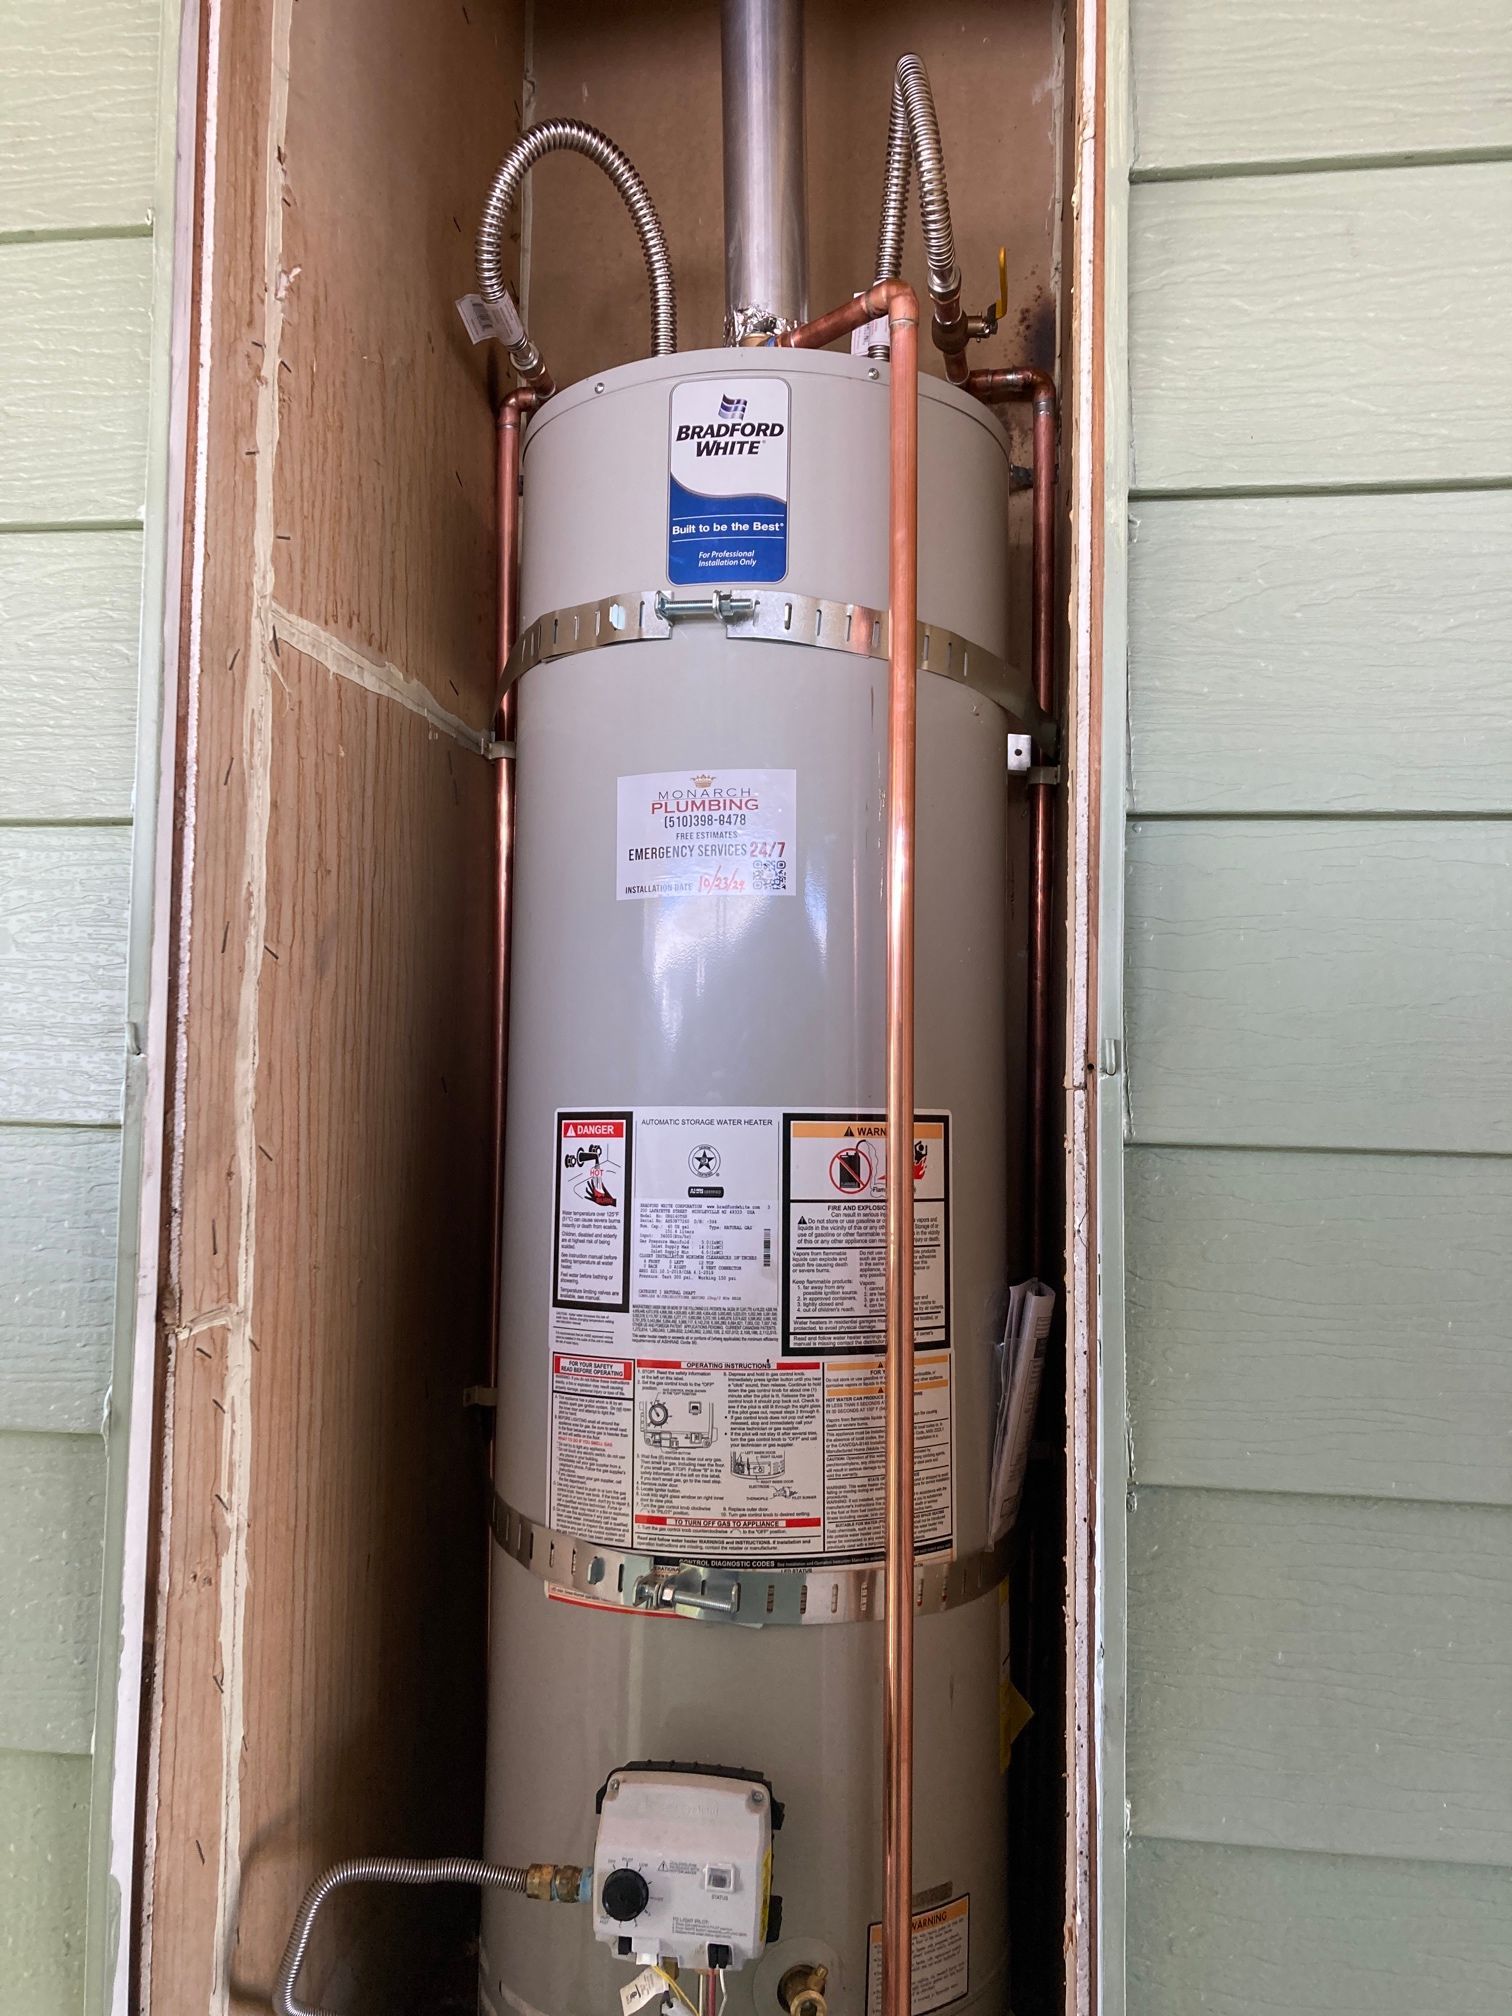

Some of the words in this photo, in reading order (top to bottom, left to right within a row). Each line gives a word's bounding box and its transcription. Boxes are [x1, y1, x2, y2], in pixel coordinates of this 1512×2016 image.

[676, 423, 784, 441] BRADFORD
[696, 440, 760, 457] WHITE
[673, 524, 695, 534] Built
[699, 524, 709, 532] to
[713, 523, 727, 531] be
[731, 522, 749, 530] the
[711, 550, 754, 558] Professional
[699, 559, 738, 567] Installation
[740, 558, 756, 567] Only
[659, 788, 750, 799] MONARCH
[652, 799, 759, 814] PLUMBING
[664, 814, 746, 828] (510)398-8478
[676, 832, 694, 840] FREE
[696, 831, 737, 839] ESTIMATES
[629, 846, 695, 861] EMERGENCY
[698, 844, 747, 857] SERVICES
[750, 842, 785, 857] 24/7
[626, 884, 672, 894] INSTALLATION
[674, 883, 692, 892] DATE
[577, 1125, 614, 1135] DANGER
[857, 1127, 887, 1136] WARN
